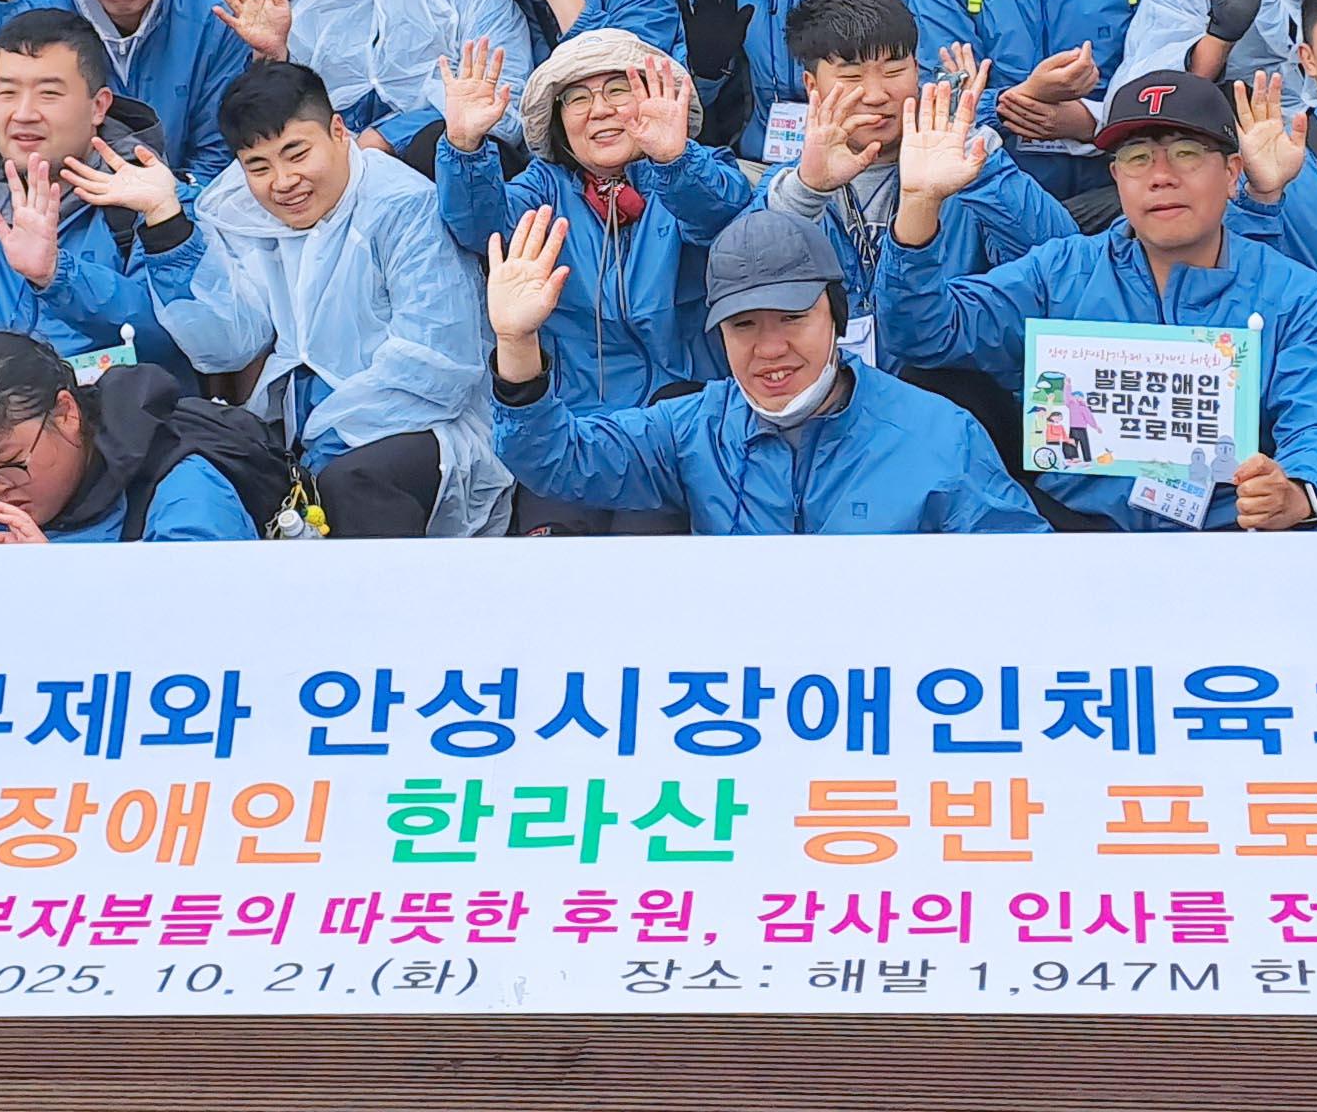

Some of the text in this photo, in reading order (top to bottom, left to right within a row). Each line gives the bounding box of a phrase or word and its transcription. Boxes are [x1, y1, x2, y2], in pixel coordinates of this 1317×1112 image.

[1095, 368, 1221, 397] 발달장애인
[1086, 391, 1221, 420] 한라산 등반
[1120, 417, 1220, 445] 프로젝트
[386, 778, 750, 864] 한라산
[794, 778, 1044, 865] 등반
[319, 891, 530, 944] 따뜻한
[553, 889, 717, 946] 후원,
[757, 891, 972, 944] 감사의
[1009, 891, 1234, 944] 인사를
[157, 964, 234, 995] 10.
[264, 958, 478, 996] 21.(화)
[621, 959, 772, 993] 장소:
[809, 959, 937, 993] 해발
[970, 961, 1219, 995] 1,947M
